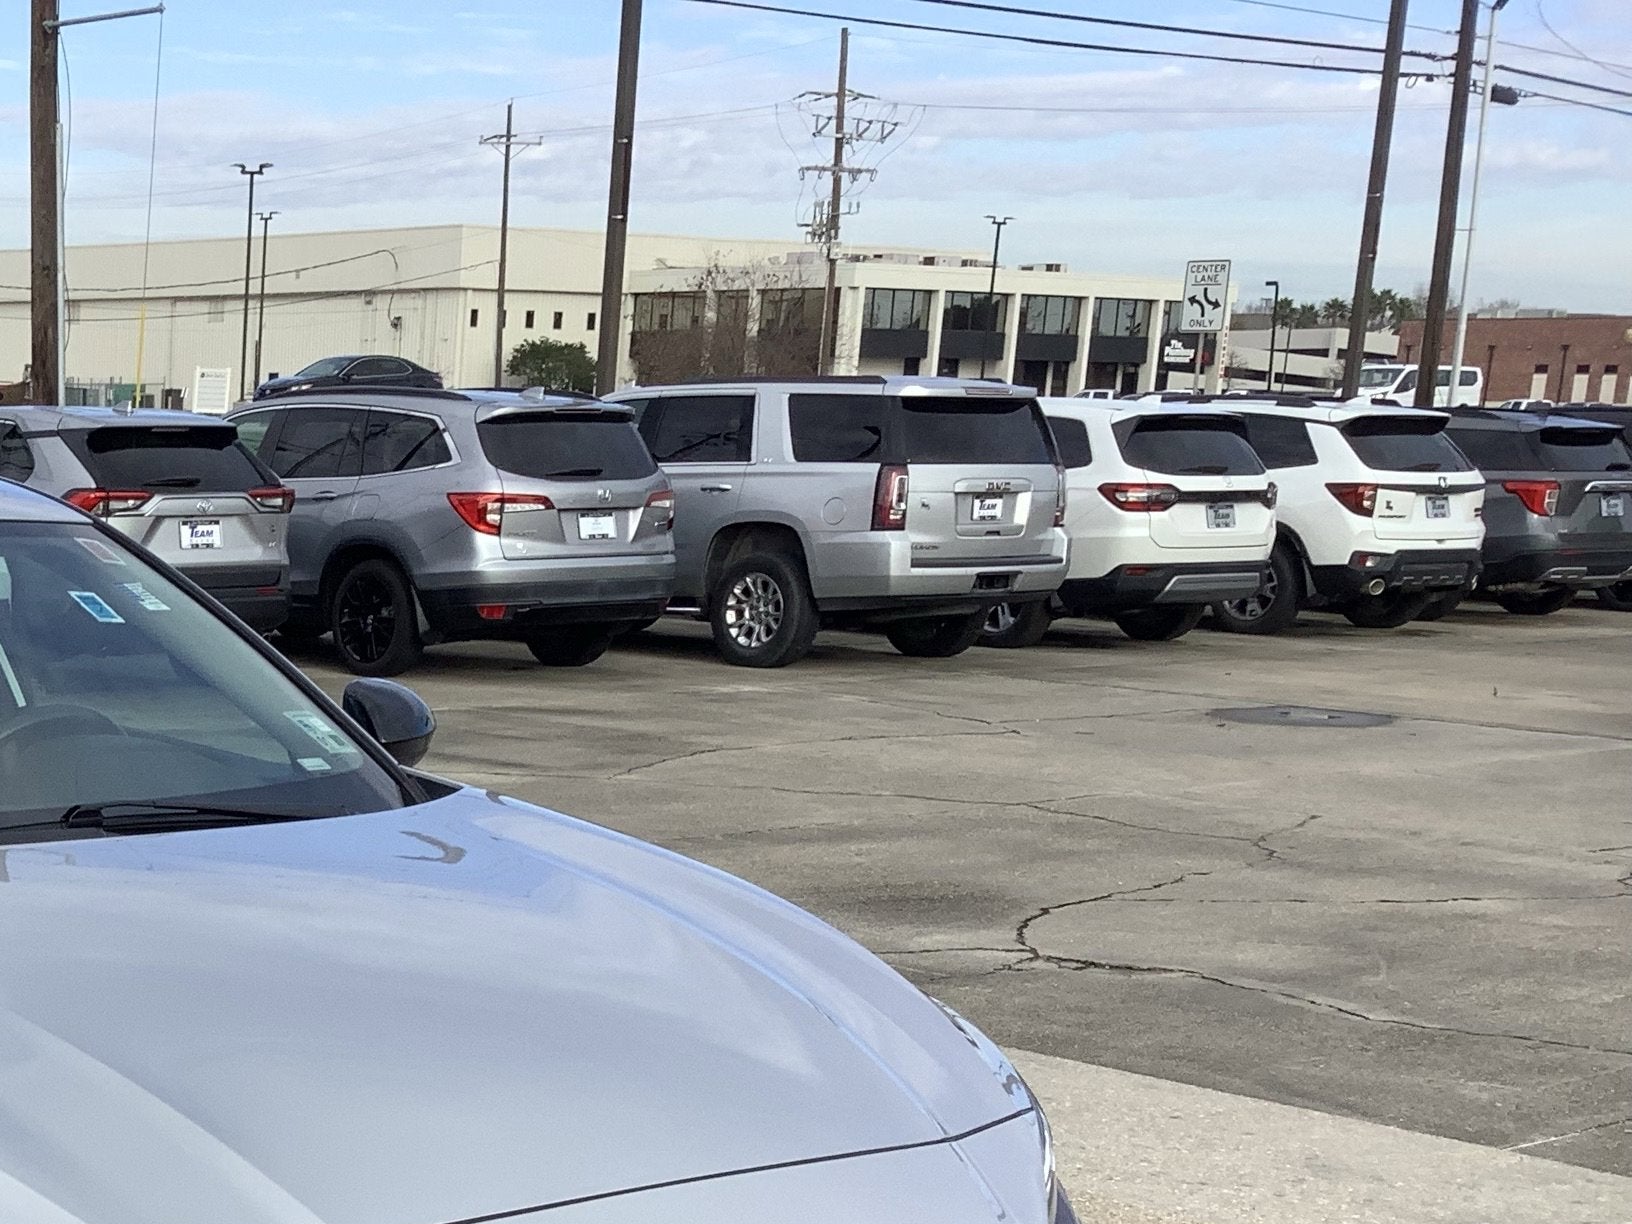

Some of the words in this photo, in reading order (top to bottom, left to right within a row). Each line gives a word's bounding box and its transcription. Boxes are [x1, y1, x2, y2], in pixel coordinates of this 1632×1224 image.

[1190, 263, 1227, 273] CENTER
[1194, 274, 1220, 283] LANE
[1189, 319, 1215, 328] ONLY
[979, 499, 998, 511] TEAM
[189, 522, 214, 539] TEAM
